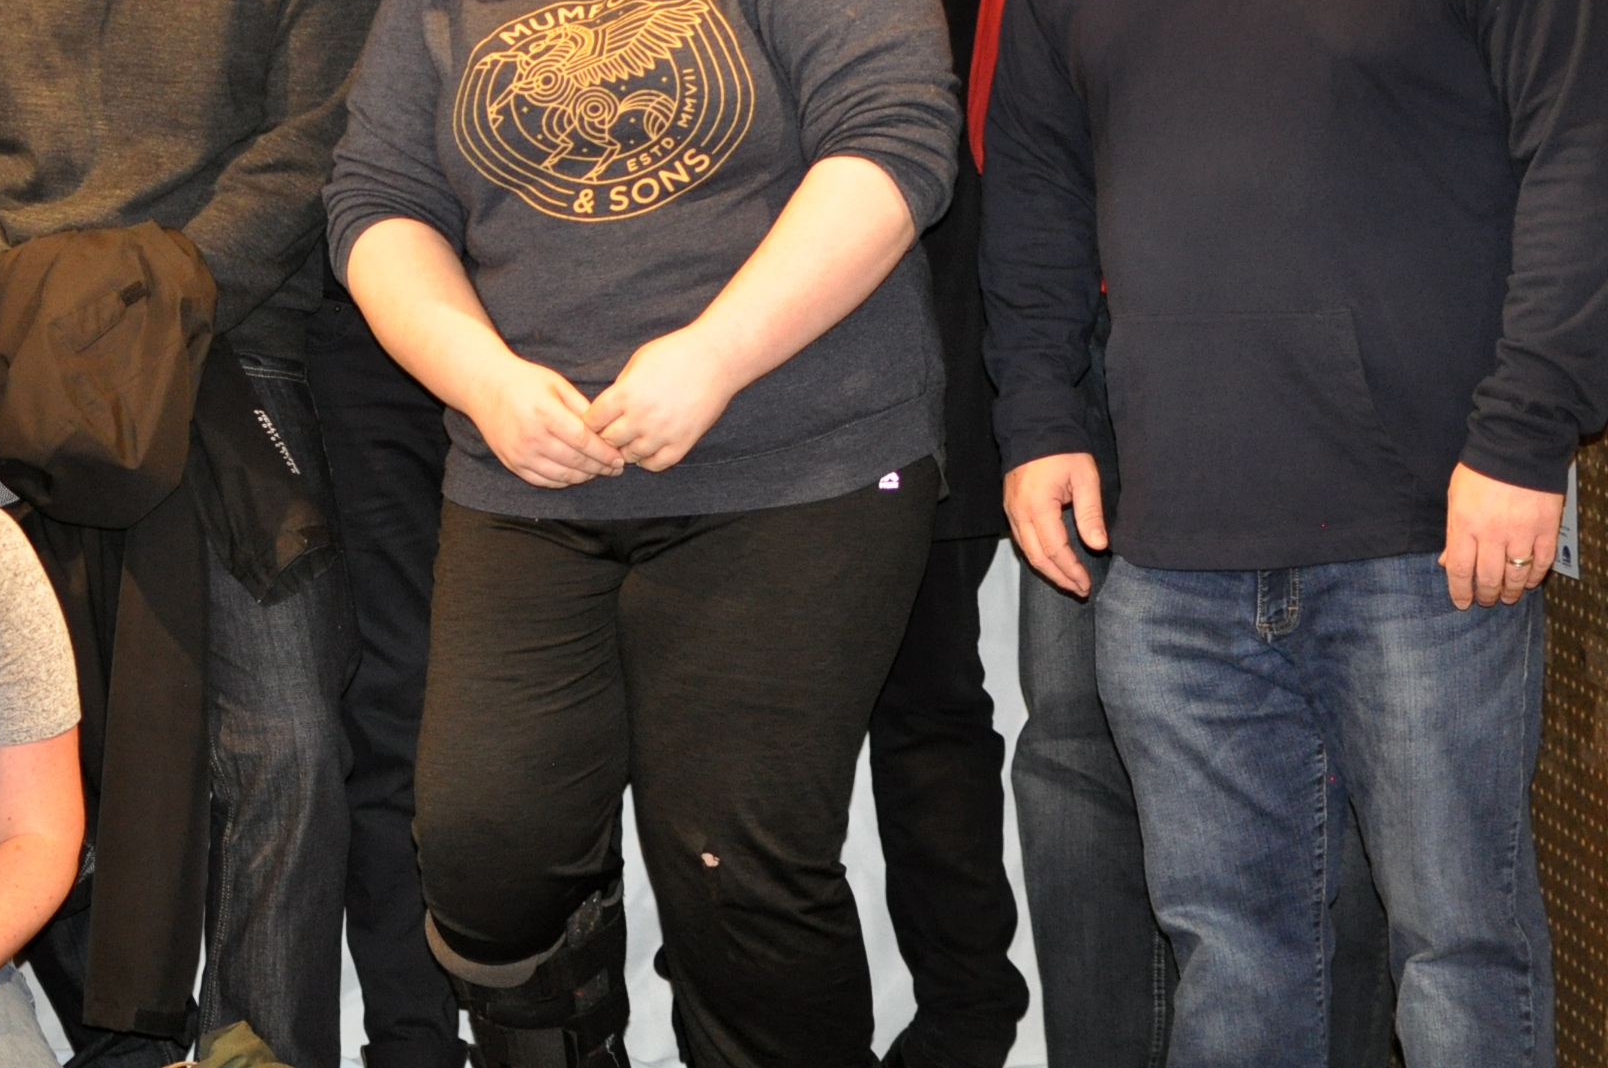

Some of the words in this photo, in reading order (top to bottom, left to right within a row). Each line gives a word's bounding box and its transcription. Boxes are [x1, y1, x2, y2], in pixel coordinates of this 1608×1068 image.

[677, 68, 698, 128] MMVII
[572, 188, 595, 214] &
[609, 148, 711, 212] SONS
